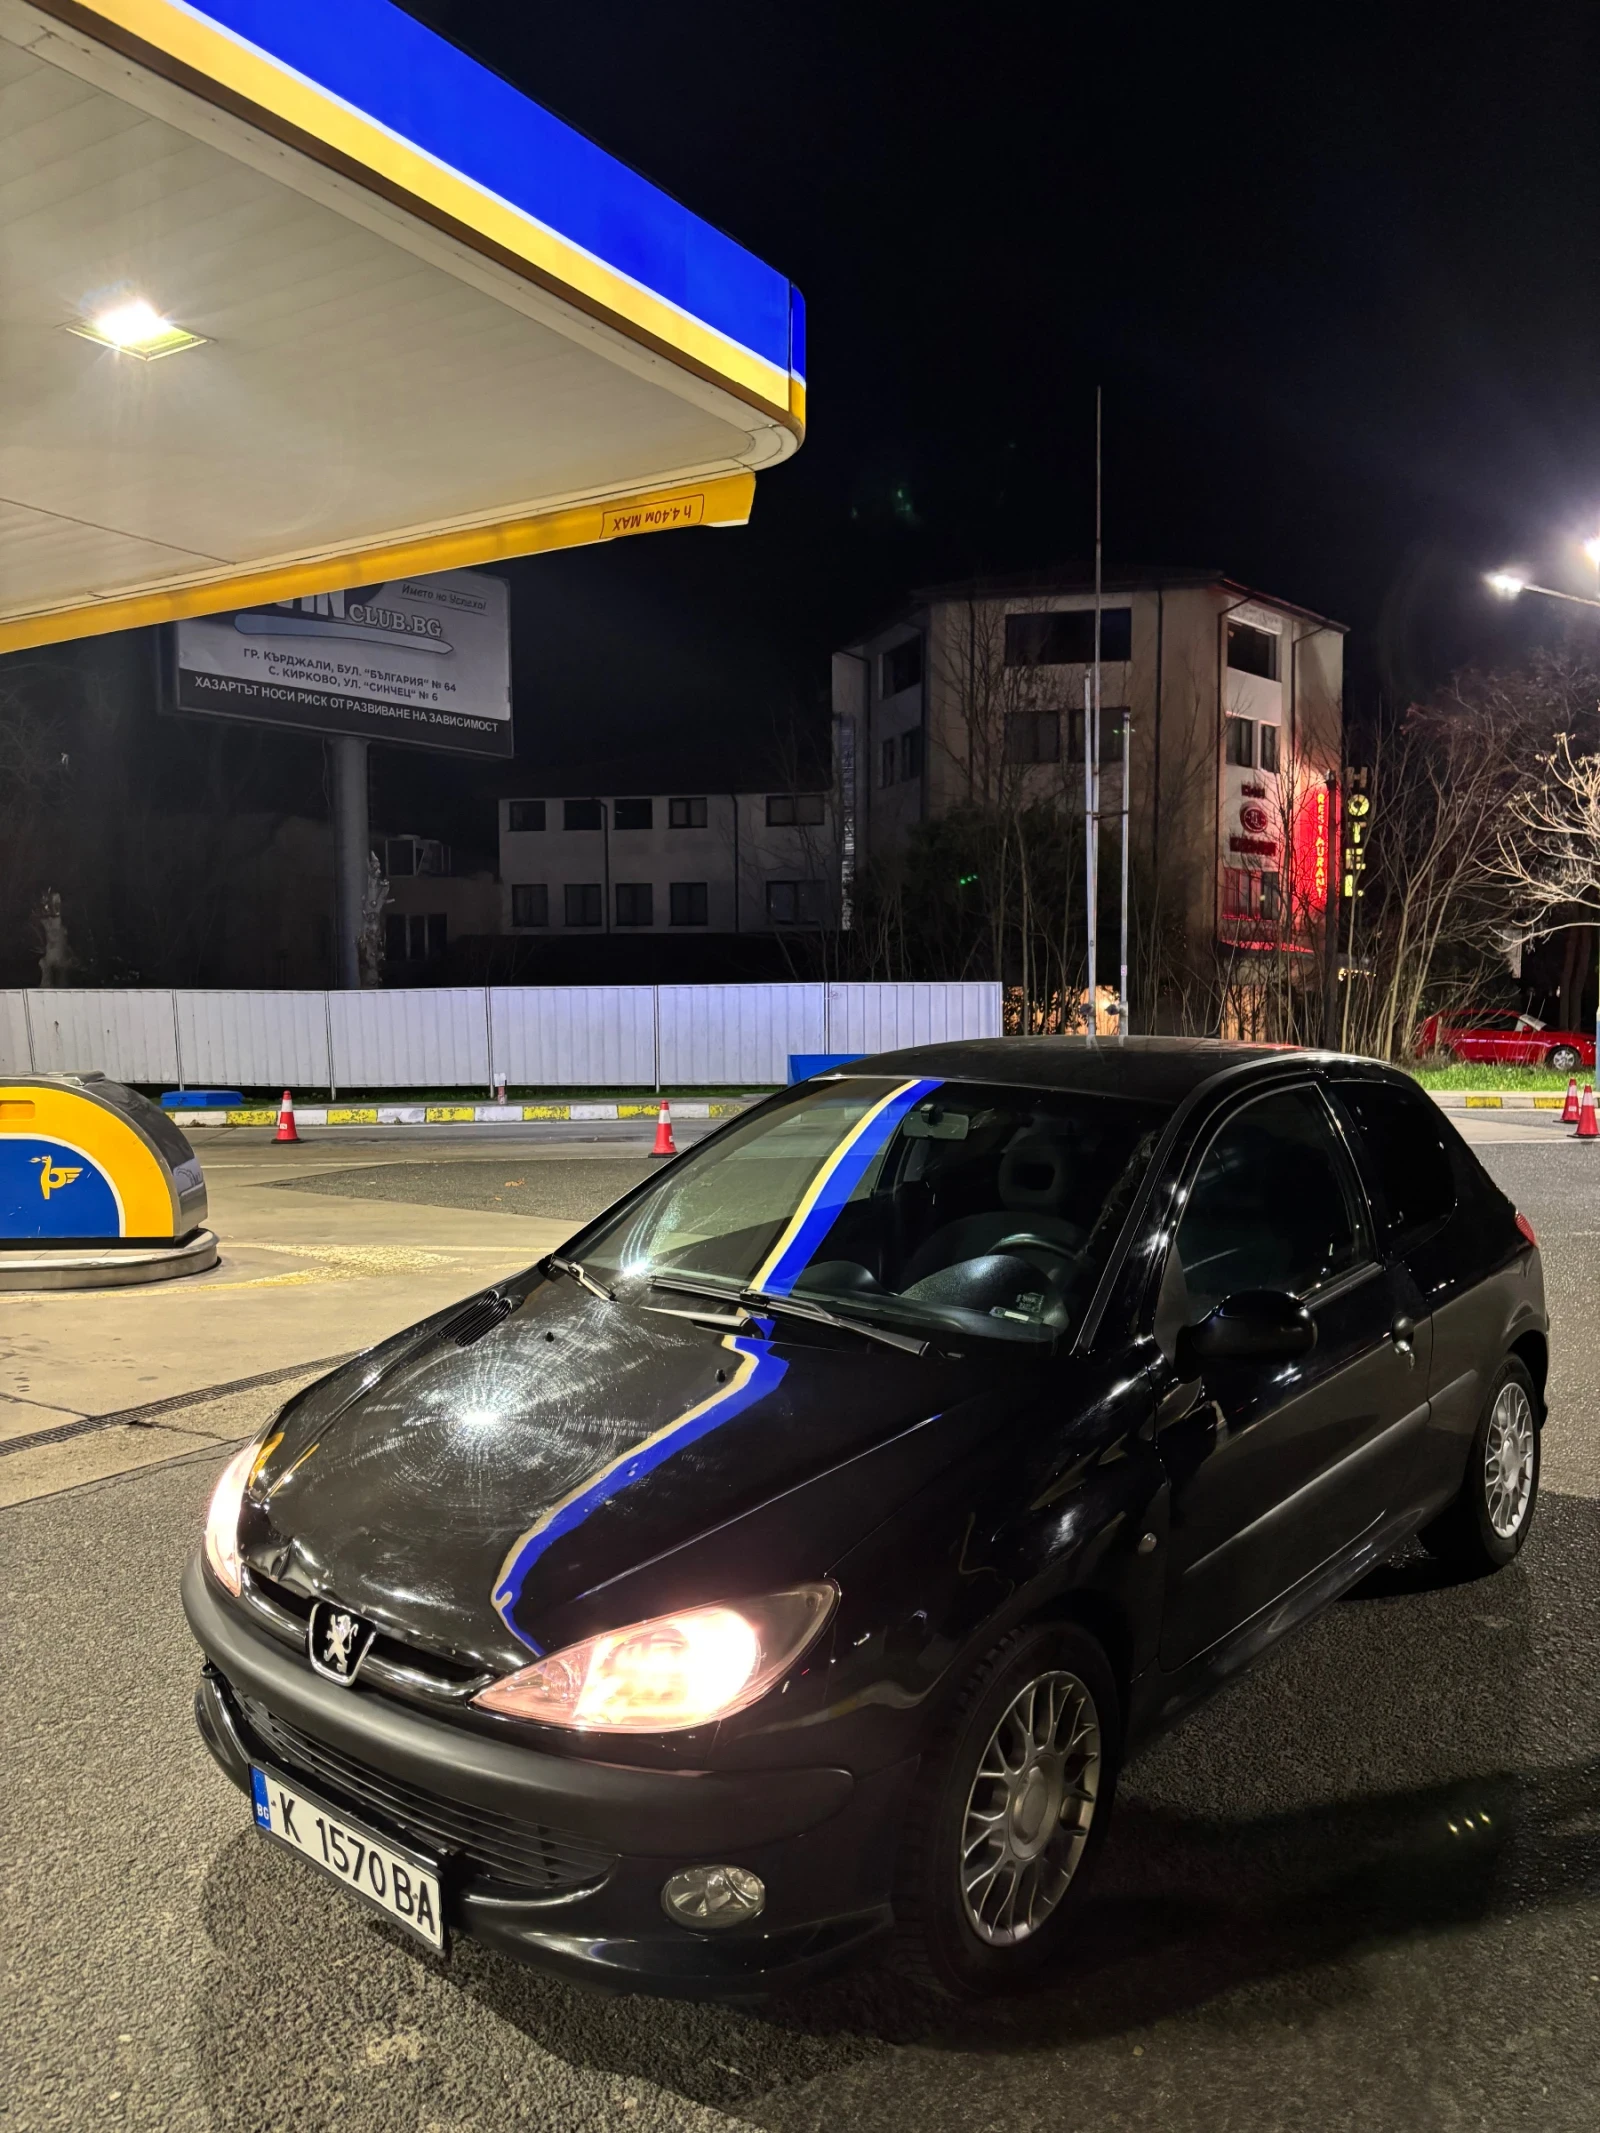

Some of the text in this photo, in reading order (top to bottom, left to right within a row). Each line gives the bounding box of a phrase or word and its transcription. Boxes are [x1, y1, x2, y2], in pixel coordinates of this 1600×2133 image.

[612, 514, 642, 532] MAX
[684, 505, 692, 518] h
[401, 583, 434, 600] Името
[350, 603, 443, 637] CLUB.BG
[243, 648, 260, 660] ГР.
[263, 651, 334, 673] КЪРДЖАЛИ,
[337, 664, 362, 677] БУЛ.
[444, 682, 457, 692] 64
[268, 666, 280, 676] С.
[283, 667, 341, 687] КИРКОВО,
[343, 678, 361, 690] УЛ.
[432, 692, 438, 701] 6
[194, 676, 499, 733] ХАЗАРТЪТ НОСИ РИСК ОТ РАЗВИВАНЕ НА ЗАВИСИМОСТ
[1315, 792, 1326, 899] RESTAURANT
[1344, 766, 1370, 897] HOTEL
[256, 1802, 270, 1820] BG
[279, 1791, 302, 1844] K
